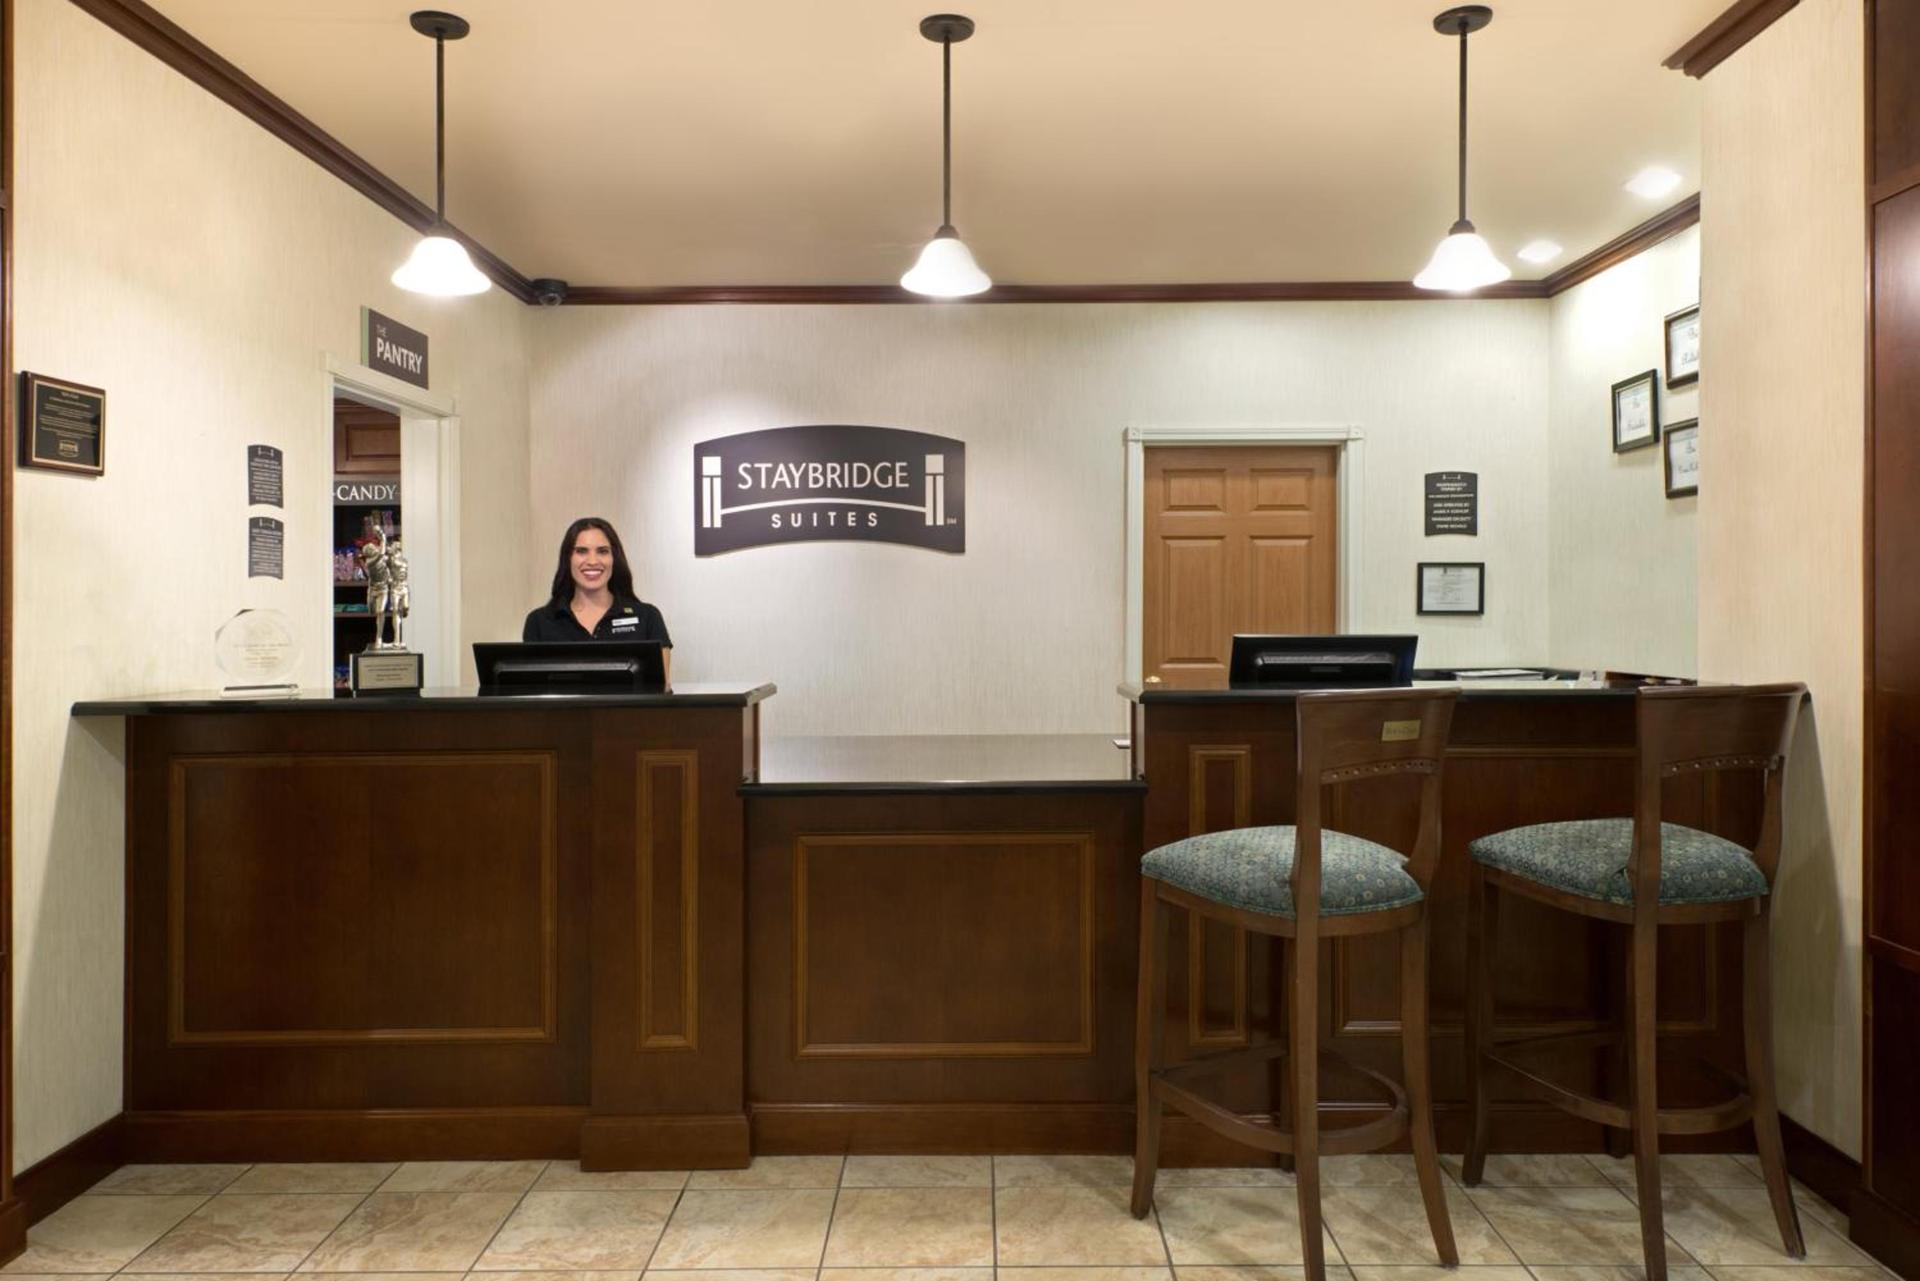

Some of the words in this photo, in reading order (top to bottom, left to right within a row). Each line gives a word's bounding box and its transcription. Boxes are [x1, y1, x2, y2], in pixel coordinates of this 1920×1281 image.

[376, 337, 423, 375] PANTRY
[737, 461, 910, 490] STAYBRIDGE
[336, 484, 397, 501] CANDY
[771, 512, 879, 529] SUITES
